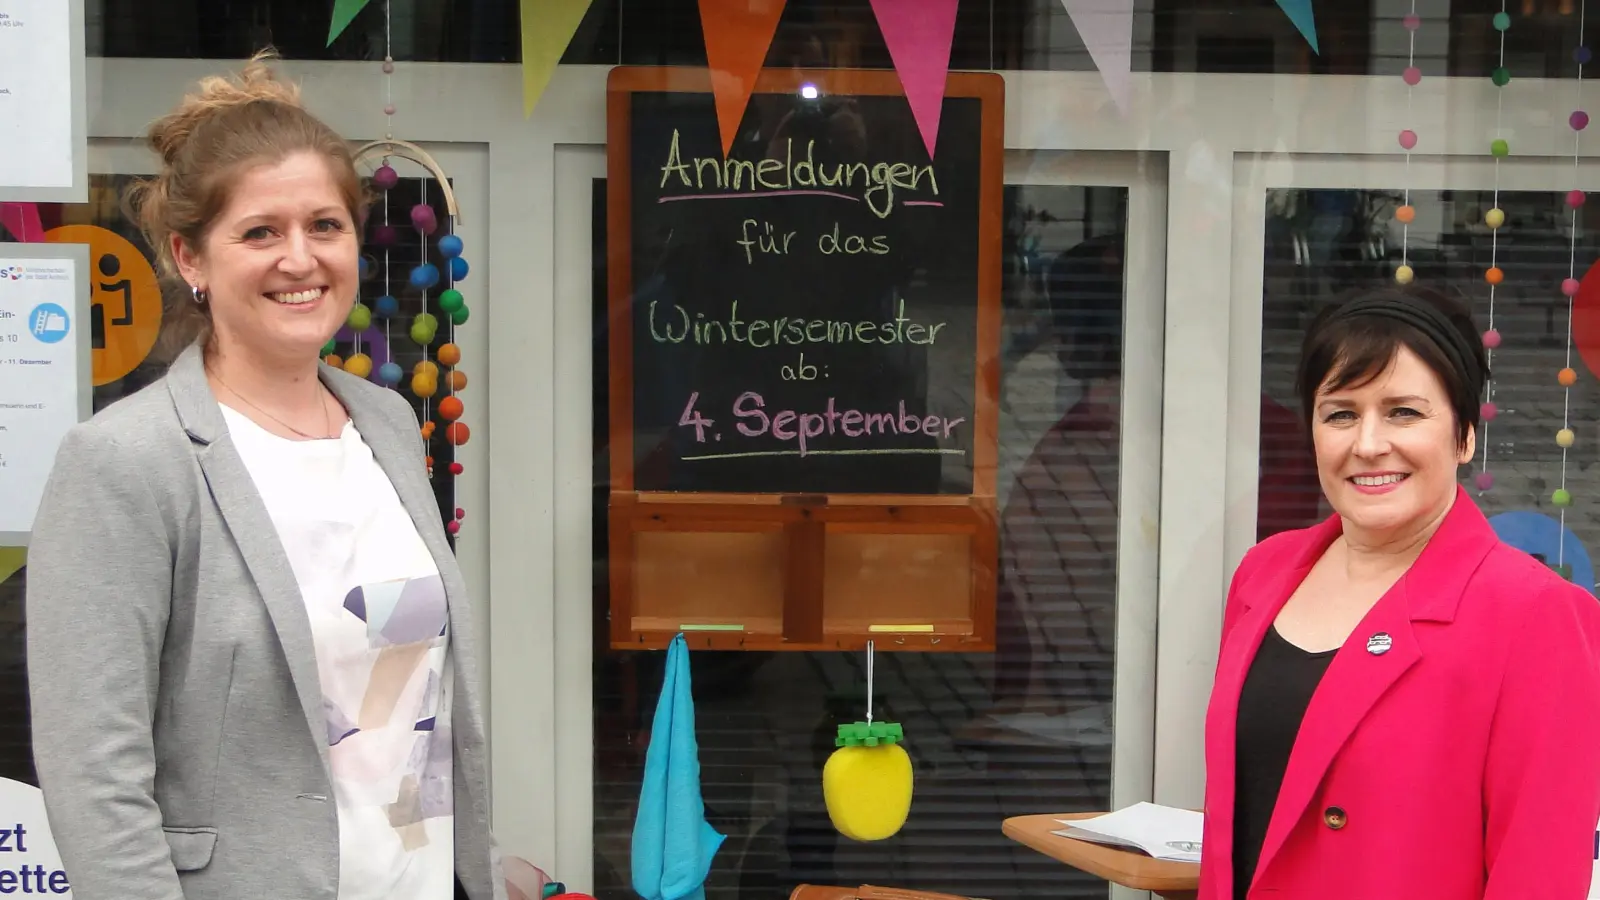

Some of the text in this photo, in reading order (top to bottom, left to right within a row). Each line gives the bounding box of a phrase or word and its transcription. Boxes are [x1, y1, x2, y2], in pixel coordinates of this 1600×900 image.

[659, 128, 939, 219] Anmeldungen
[737, 218, 891, 264] für das
[649, 299, 947, 348] Wintersemester
[780, 352, 831, 381] ab:
[678, 391, 966, 457] 4. September
[0, 823, 28, 852] zt
